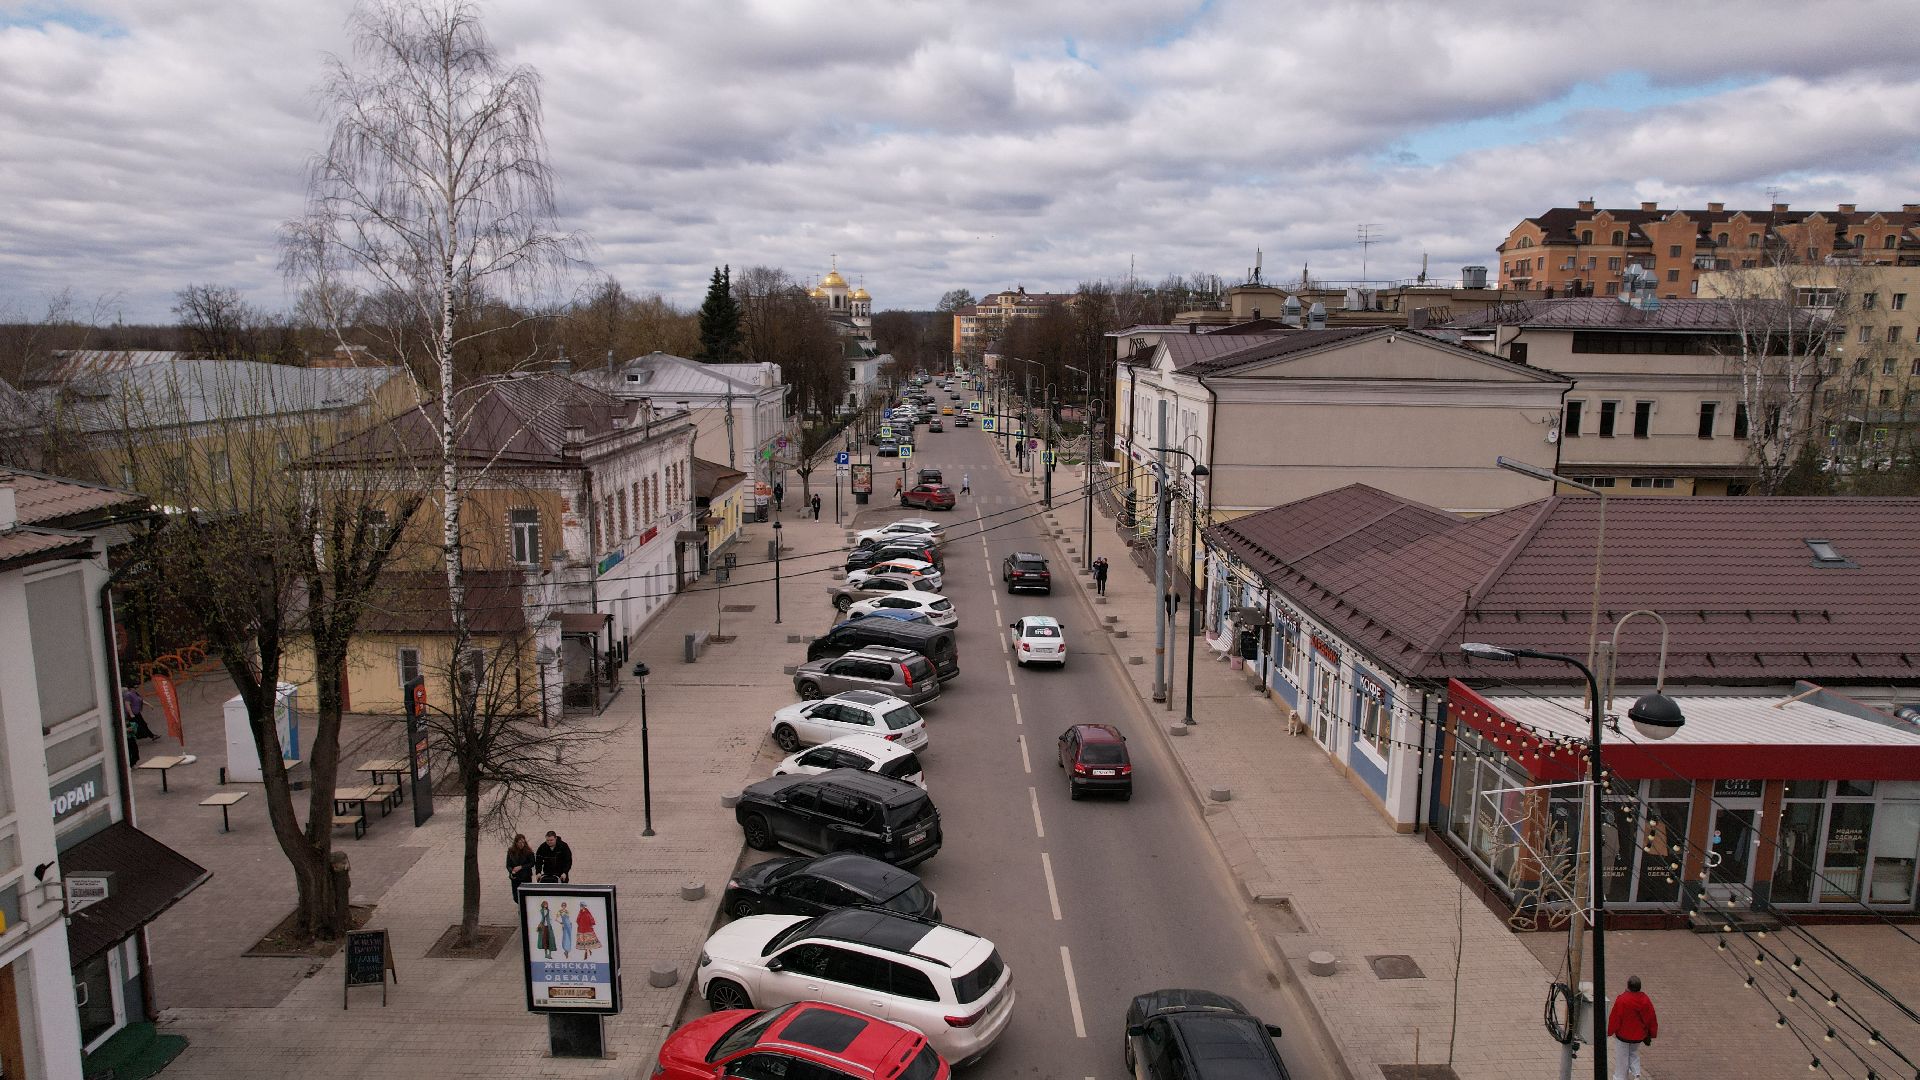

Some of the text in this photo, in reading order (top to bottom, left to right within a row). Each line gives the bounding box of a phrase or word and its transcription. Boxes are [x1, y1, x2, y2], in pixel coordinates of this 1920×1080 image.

[840, 453, 848, 463] P
[1360, 675, 1382, 700] КОФЕ
[544, 962, 597, 970] ЖЕНСКАЯ
[544, 974, 597, 982] ОДЕЖДА
